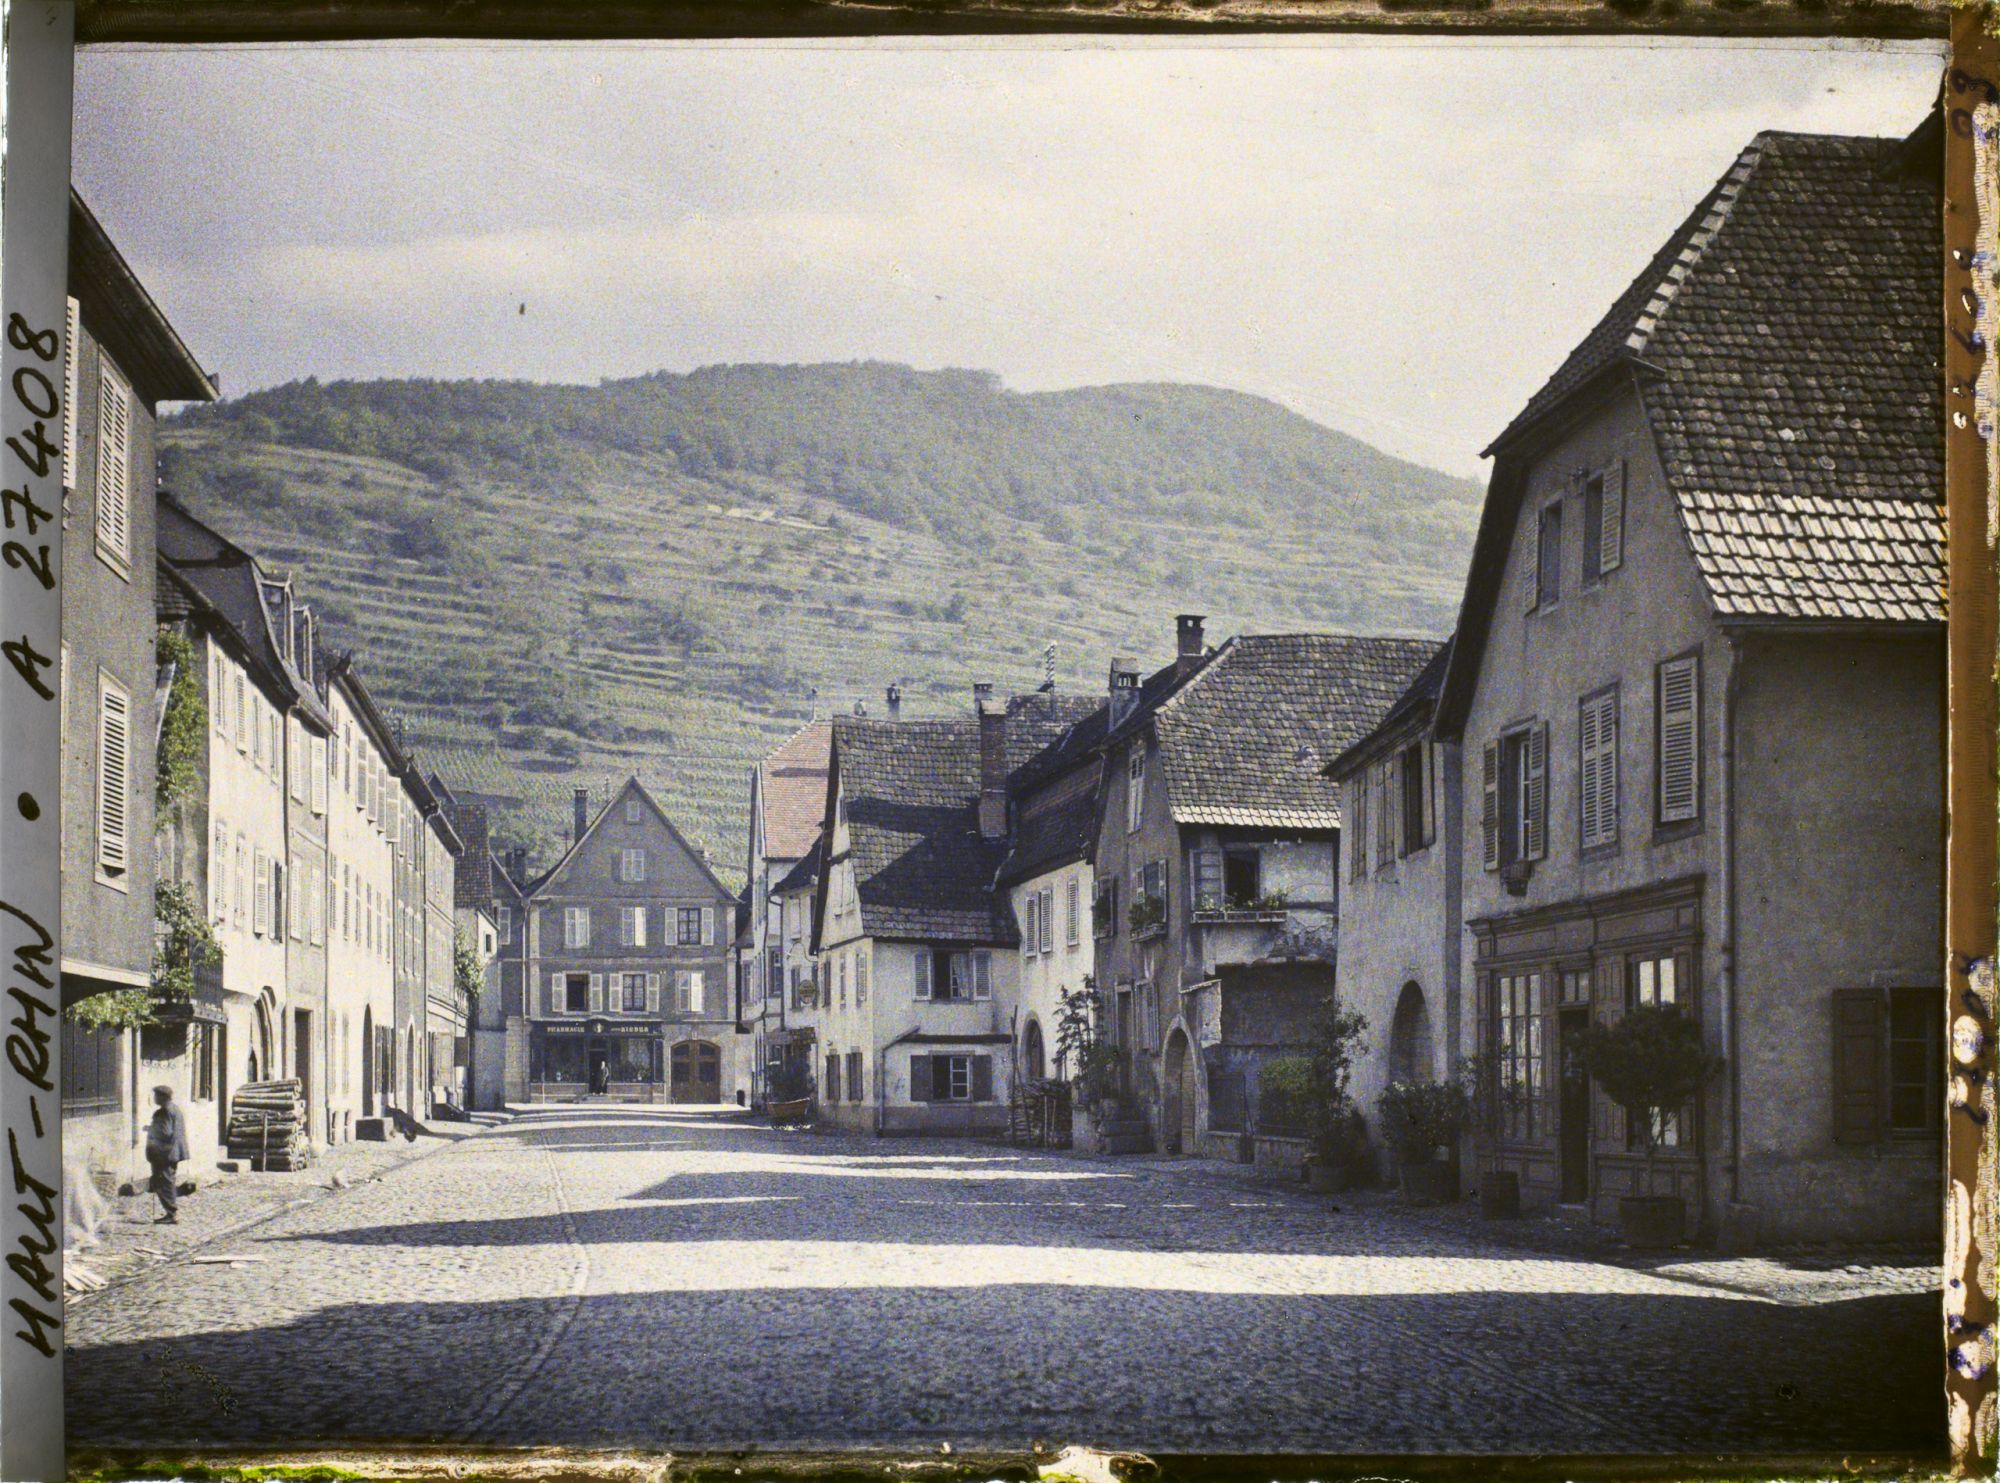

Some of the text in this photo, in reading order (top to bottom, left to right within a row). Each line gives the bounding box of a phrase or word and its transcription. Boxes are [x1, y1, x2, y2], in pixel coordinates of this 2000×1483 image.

[1, 313, 61, 1358] HAUT-RHIN A 27408
